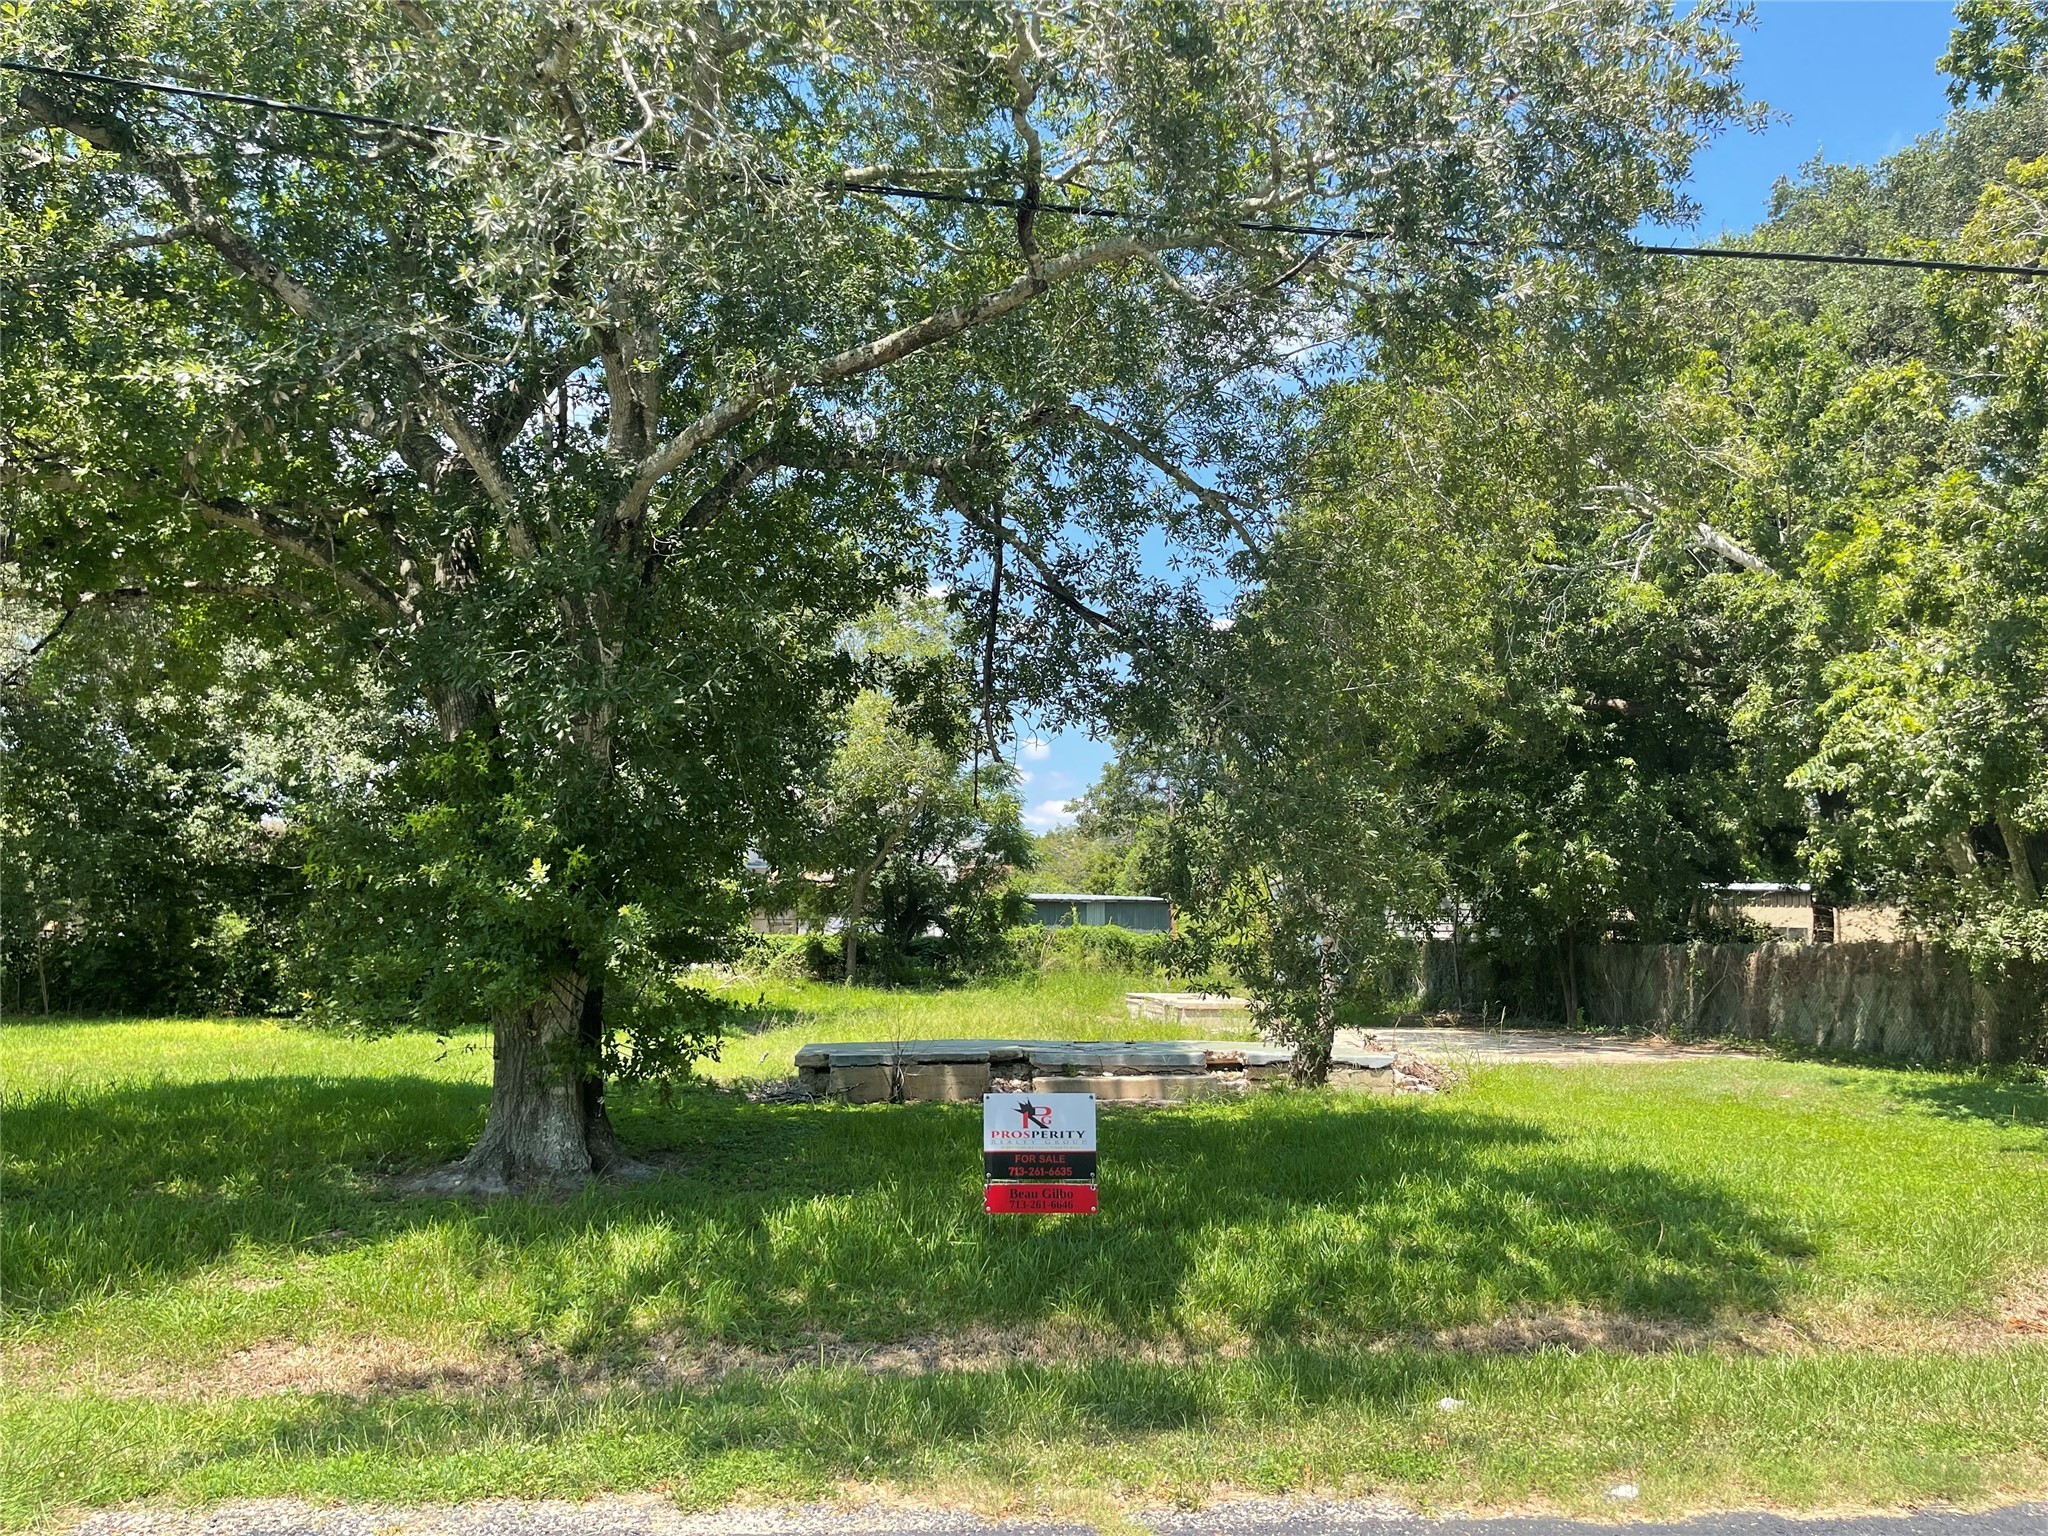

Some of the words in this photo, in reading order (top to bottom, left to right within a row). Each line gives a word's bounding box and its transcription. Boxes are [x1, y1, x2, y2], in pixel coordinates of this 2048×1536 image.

[991, 1130, 1086, 1139] PROSPERITY
[1015, 1155, 1036, 1163] FOR
[1039, 1155, 1065, 1163] SALE
[1008, 1167, 1073, 1176] 713-261-6635
[1010, 1188, 1038, 1199] Beau
[1010, 1200, 1074, 1209] 713-261-6646
